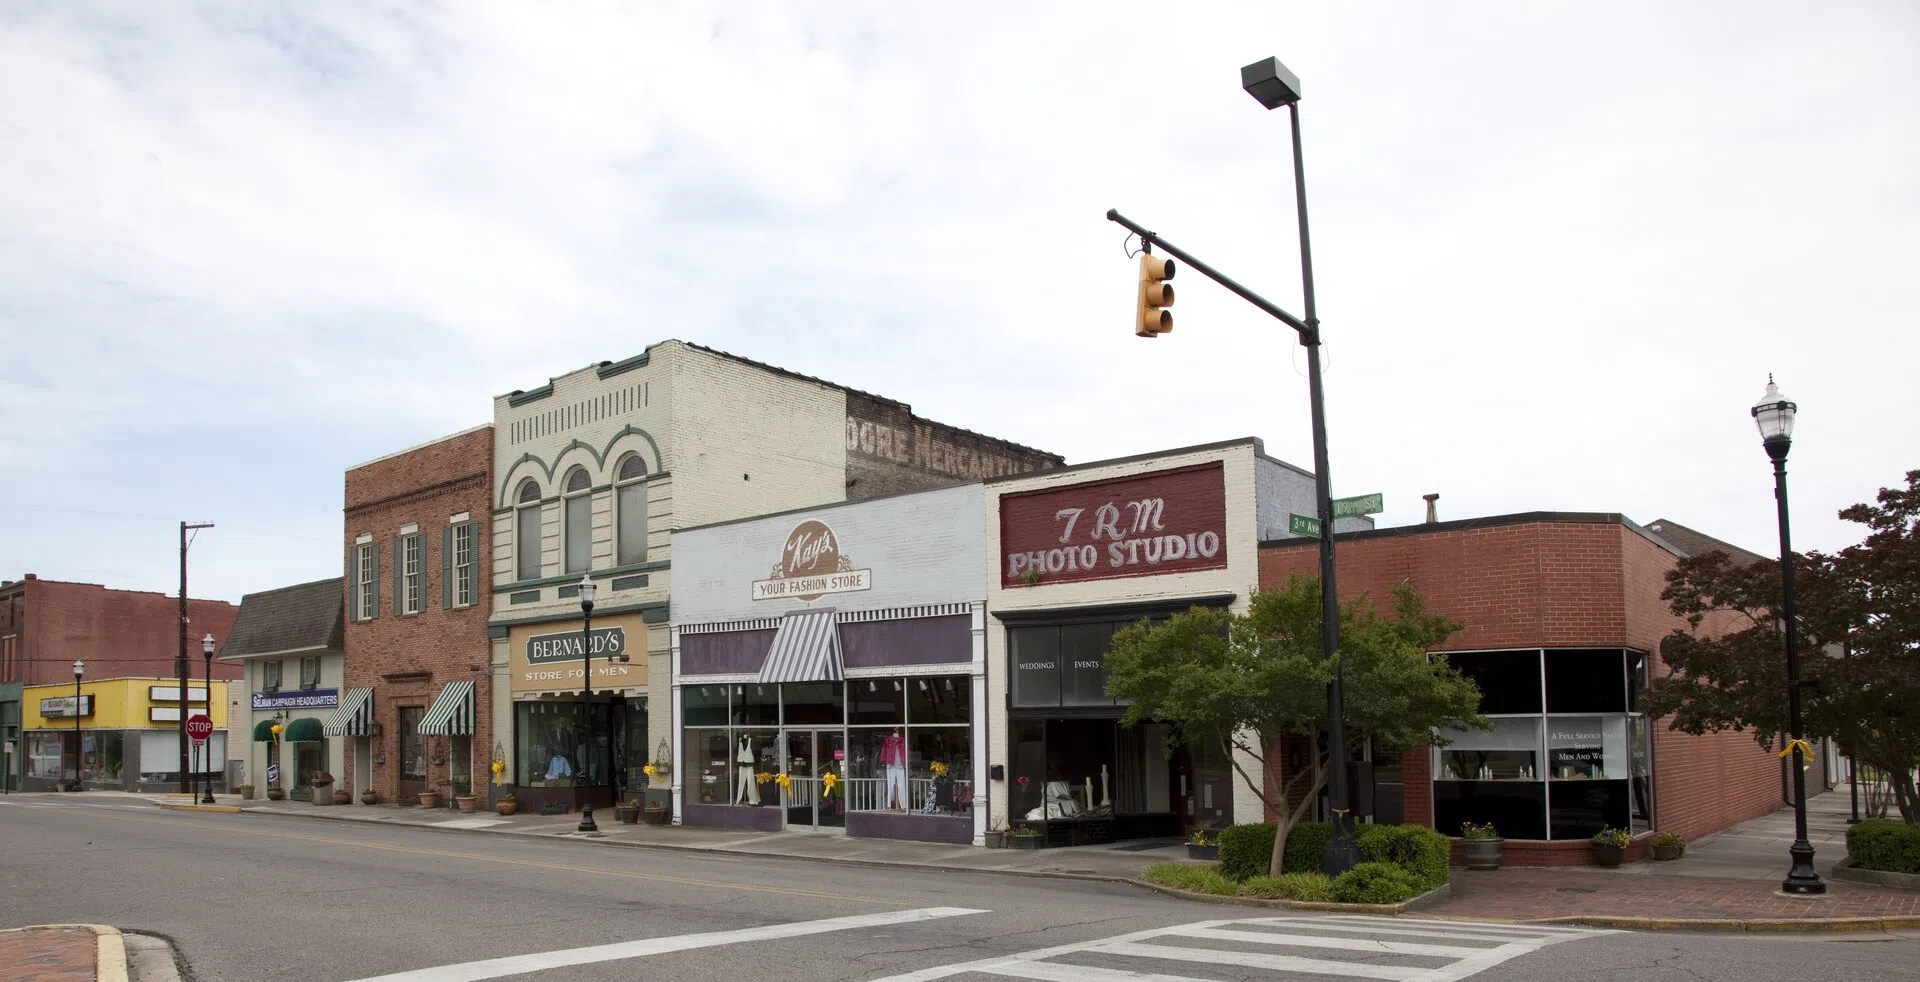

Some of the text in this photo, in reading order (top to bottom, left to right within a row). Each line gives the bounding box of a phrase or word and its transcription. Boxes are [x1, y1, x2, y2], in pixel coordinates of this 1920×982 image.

[1294, 517, 1320, 534] 3rd Ave
[787, 530, 833, 573] Kay's
[1007, 531, 1220, 578] PHOTO STUDIO
[760, 575, 862, 596] YOUR FASHION STORE
[1019, 660, 1099, 670] WEDDINGS EVENTS
[525, 670, 563, 681] STORE
[599, 666, 628, 676] MEN
[272, 697, 296, 707] CAMPAIGN
[297, 695, 338, 706] HEADQUARTERS
[188, 722, 212, 733] STOP
[1558, 732, 1575, 740] FULL
[1575, 732, 1601, 740] SERVICE
